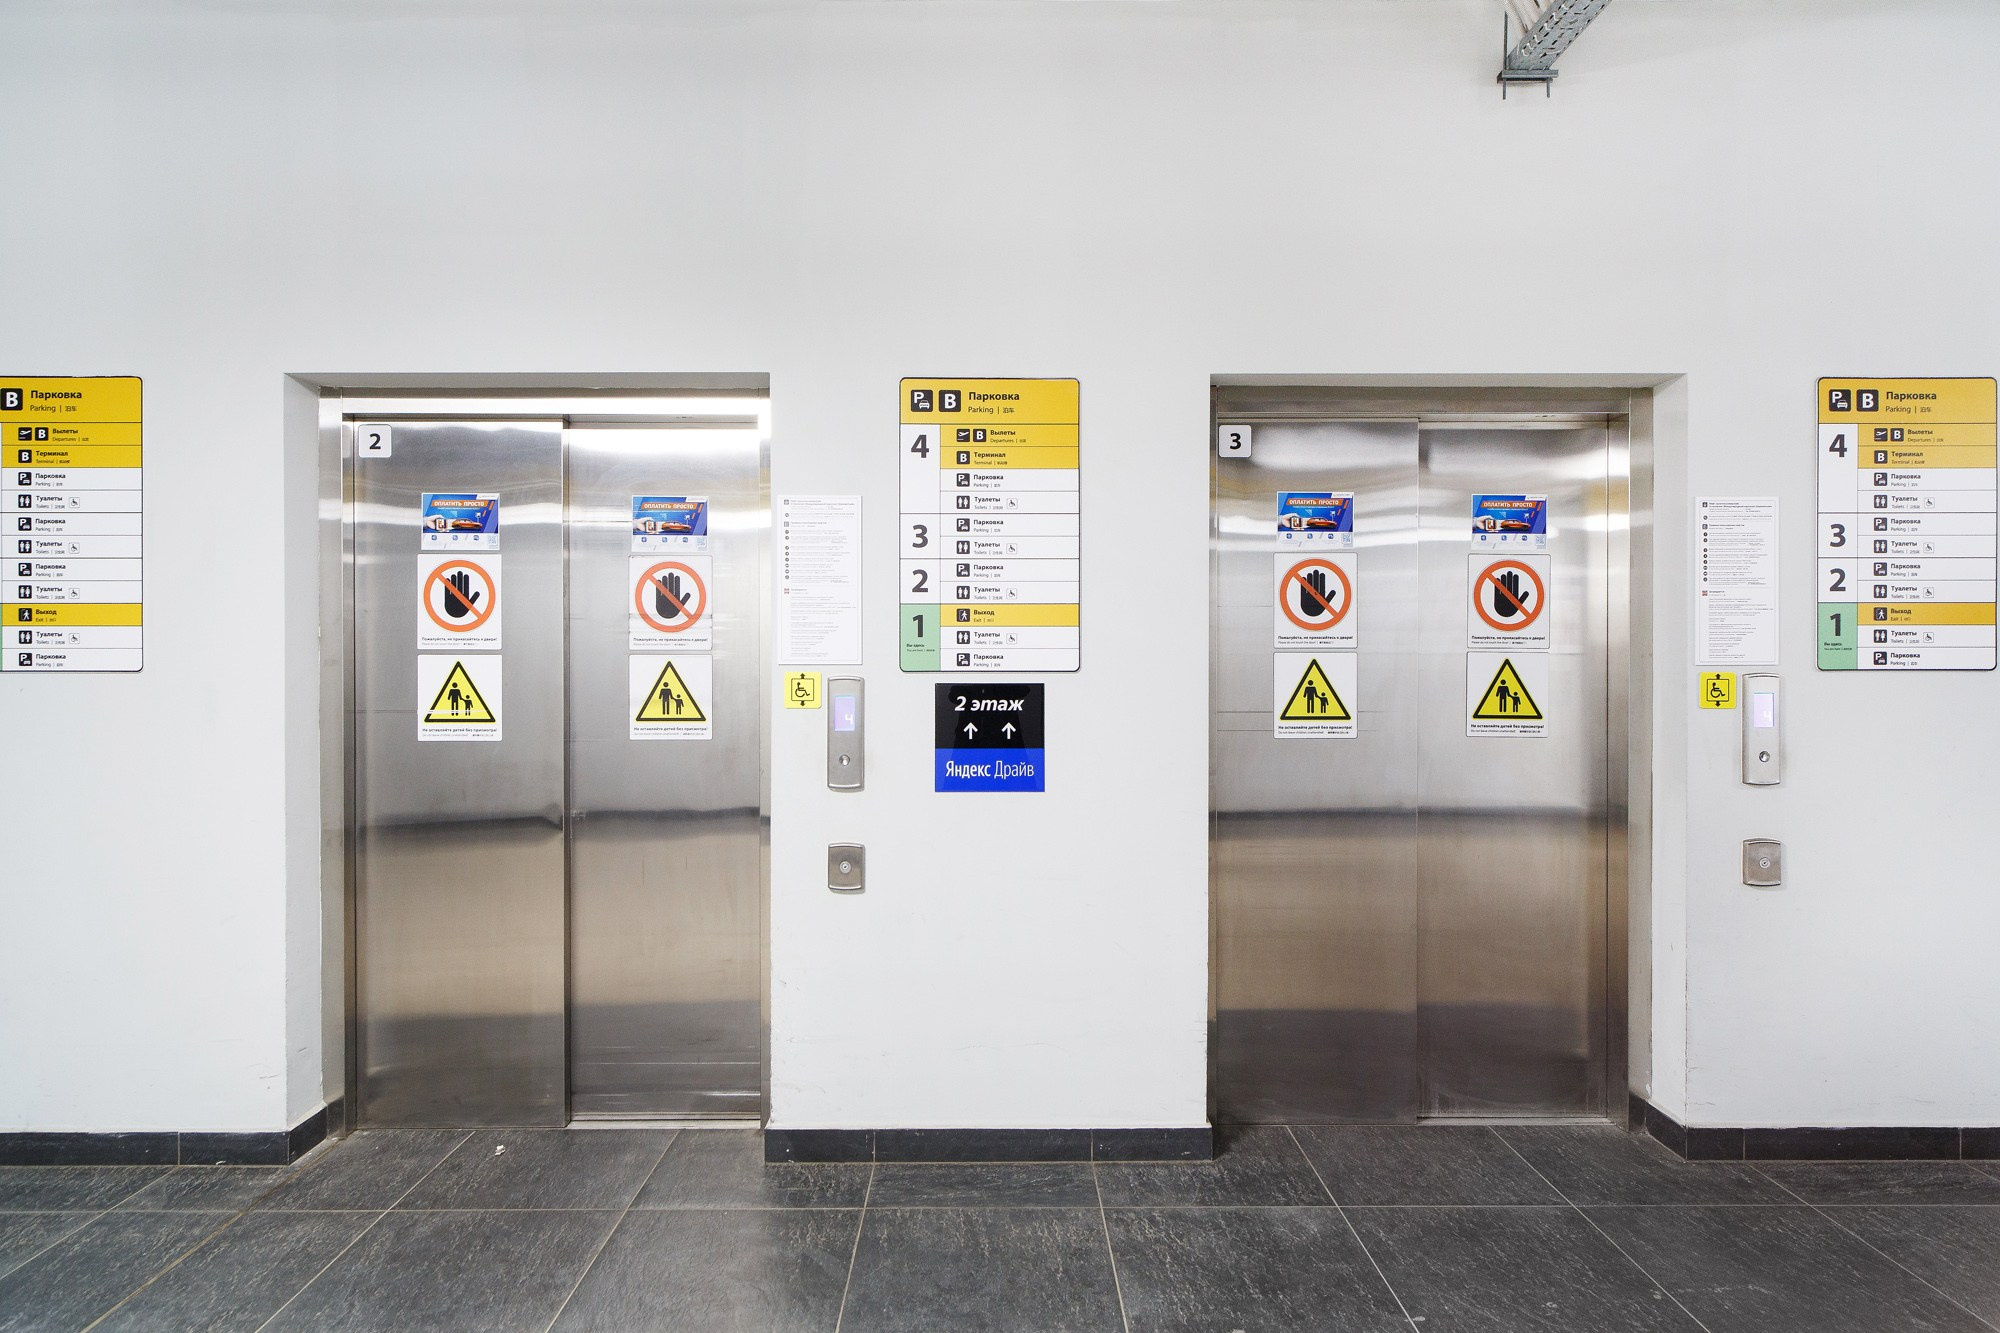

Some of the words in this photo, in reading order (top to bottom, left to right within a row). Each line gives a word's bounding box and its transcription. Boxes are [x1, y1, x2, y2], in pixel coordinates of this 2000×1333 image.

[6, 392, 18, 407] B
[31, 390, 82, 401] Парковка
[914, 392, 925, 404] P
[945, 394, 956, 408] B
[969, 392, 1019, 402] Парковка
[1832, 392, 1843, 403] P
[1863, 393, 1873, 408] B
[1887, 392, 1936, 402] Парковка
[30, 405, 56, 413] Parking
[968, 406, 993, 414] Parking
[1886, 406, 1911, 414] Parking
[39, 429, 45, 438] B
[369, 433, 381, 449] 2
[977, 431, 983, 440] B
[1230, 433, 1241, 449] 3
[1894, 430, 1901, 439] B
[911, 435, 929, 458] 4
[1829, 434, 1847, 457] 4
[22, 452, 29, 461] B
[960, 453, 967, 462] B
[1878, 453, 1884, 461] B
[912, 525, 928, 548] 3
[1830, 524, 1846, 547] 3
[912, 569, 928, 592] 2
[1830, 568, 1846, 591] 2
[913, 615, 923, 637] 1
[1830, 614, 1841, 636] 1
[955, 696, 966, 711] 2
[971, 700, 1024, 711] этаж
[946, 761, 991, 778] Яндекс
[994, 761, 1034, 779] Драйв
